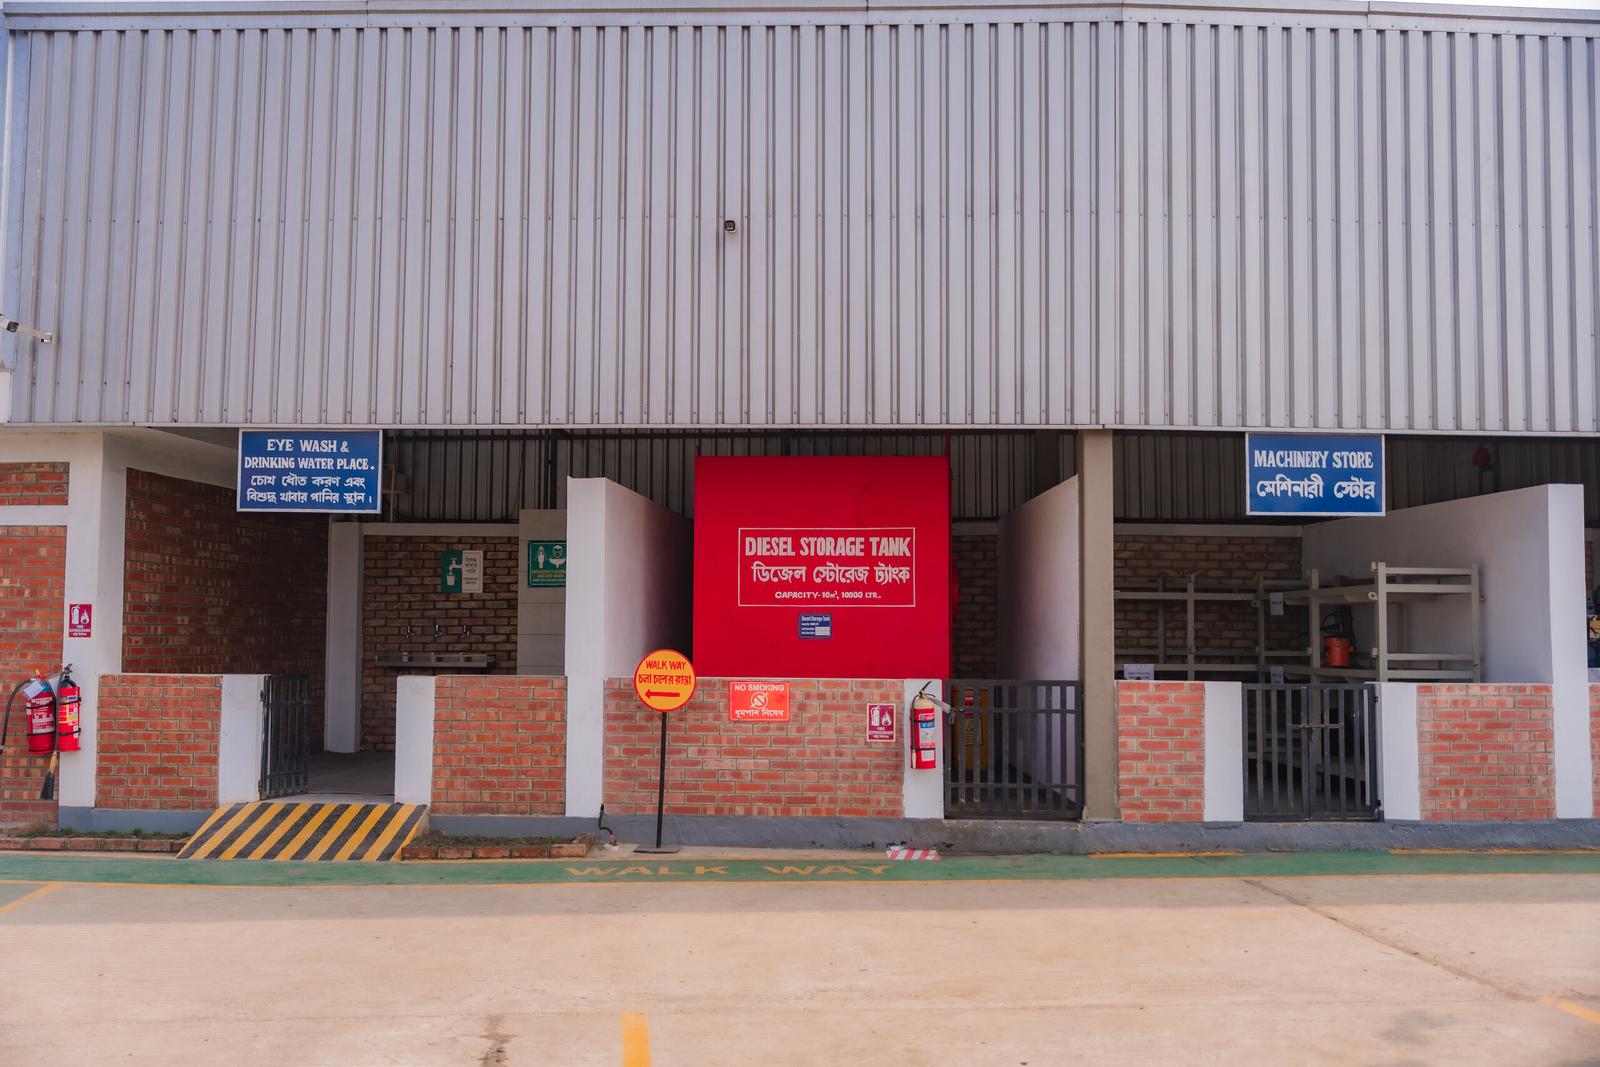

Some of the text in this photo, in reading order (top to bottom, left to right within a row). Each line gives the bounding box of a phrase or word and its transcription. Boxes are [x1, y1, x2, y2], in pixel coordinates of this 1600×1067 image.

[267, 439, 350, 453] EYE WASH &
[244, 457, 295, 469] DRINKING
[298, 458, 334, 470] WATER
[1254, 450, 1374, 469] MACHINERY STORE
[251, 475, 276, 486] চোখ
[281, 472, 308, 487] ধৌত
[343, 477, 366, 489] এবং
[1256, 473, 1376, 500] মেশিনারী স্টোর
[280, 491, 308, 503] খাবার
[310, 488, 340, 504] পানির
[343, 491, 366, 506] স্থান
[745, 536, 911, 557] DIESEL STORAGE TANK
[751, 560, 807, 583] ডিজেল
[812, 562, 870, 584] স্টোরেজ
[841, 591, 863, 599] 10000
[645, 660, 686, 670] WALK WAY
[748, 684, 785, 692] SMOKING
[565, 865, 892, 877] WALK WAY
